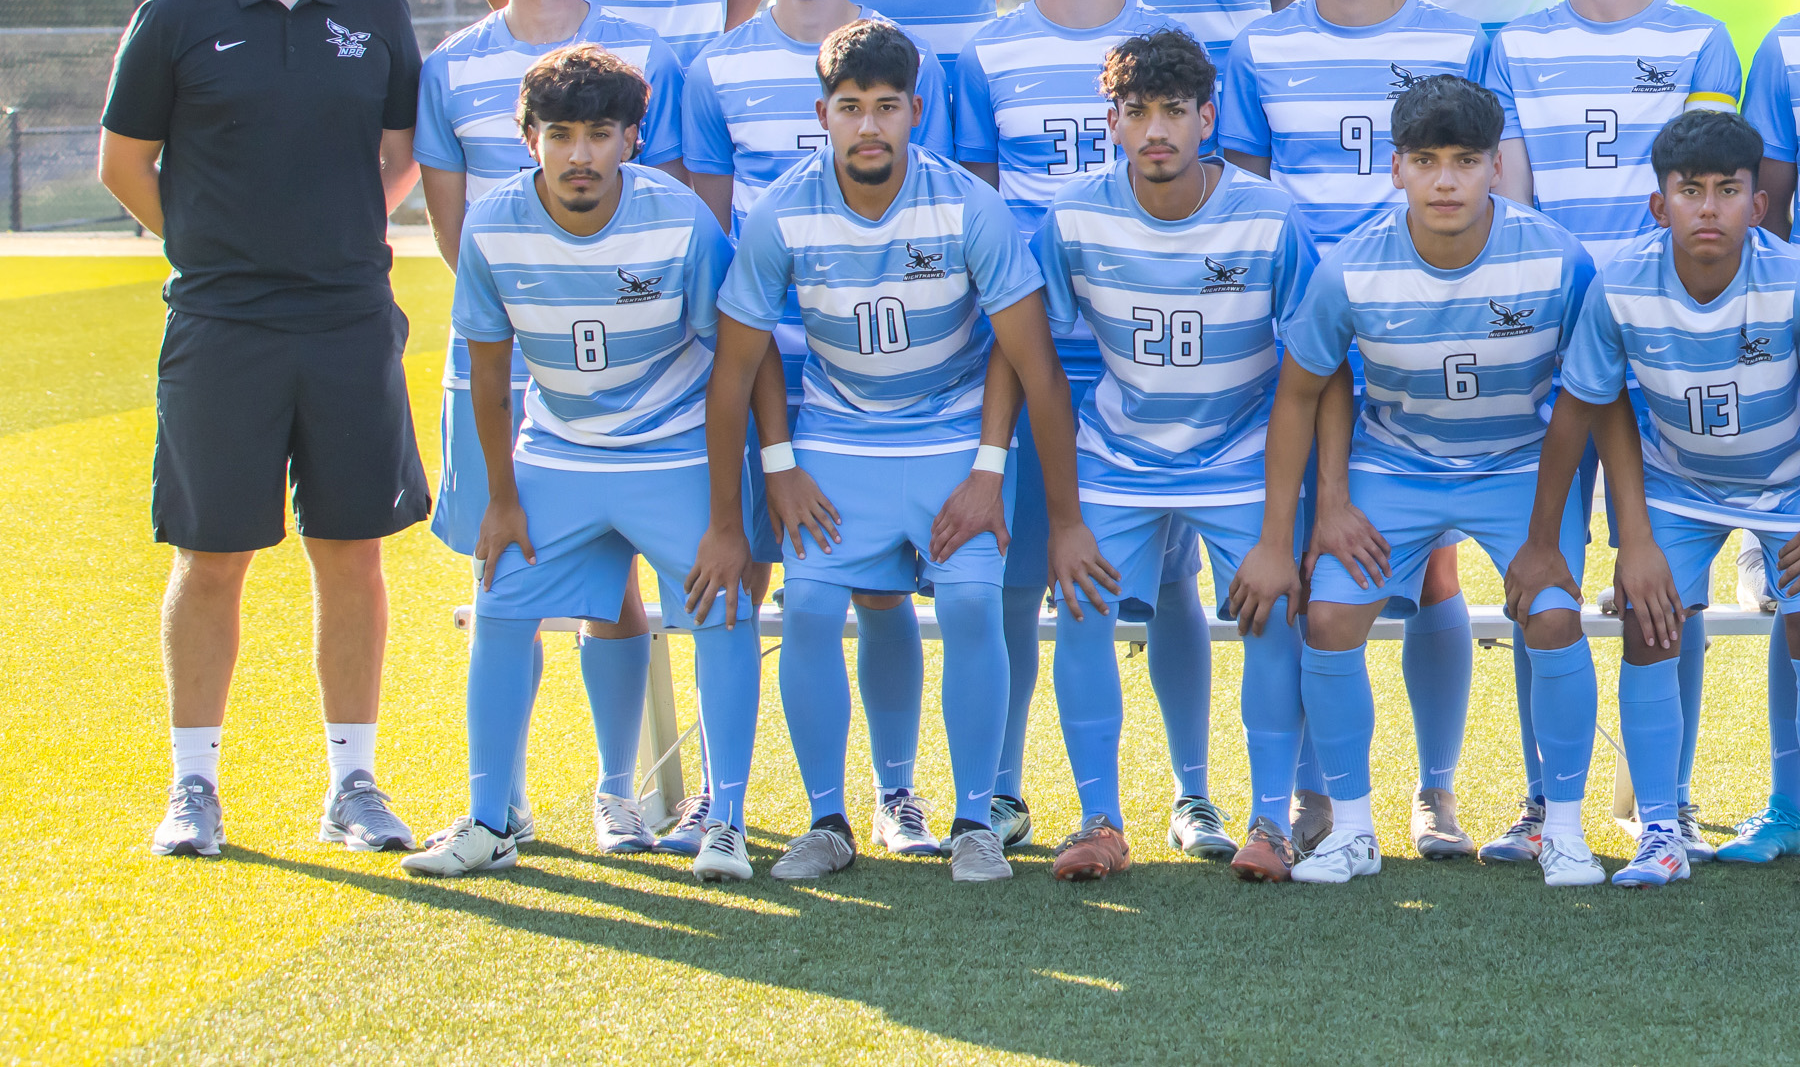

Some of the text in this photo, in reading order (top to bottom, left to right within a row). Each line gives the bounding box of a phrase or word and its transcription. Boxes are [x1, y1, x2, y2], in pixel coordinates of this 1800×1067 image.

[338, 46, 366, 57] NPC
[1631, 84, 1676, 93] NIGHTHAWKS
[1044, 118, 1117, 175] 33
[1340, 115, 1373, 175] 9
[1585, 109, 1618, 169] 2
[616, 292, 661, 304] NIGHTHAWKS
[903, 270, 944, 281] NIGHTHAWKS
[1200, 284, 1245, 294] NIGHTHAWKS
[572, 320, 608, 372] 8
[854, 297, 910, 355] 10
[1132, 306, 1203, 367] 28
[1488, 327, 1533, 339] NIGHTHAWKS
[1443, 353, 1480, 401] 6
[1684, 381, 1741, 437] 13
